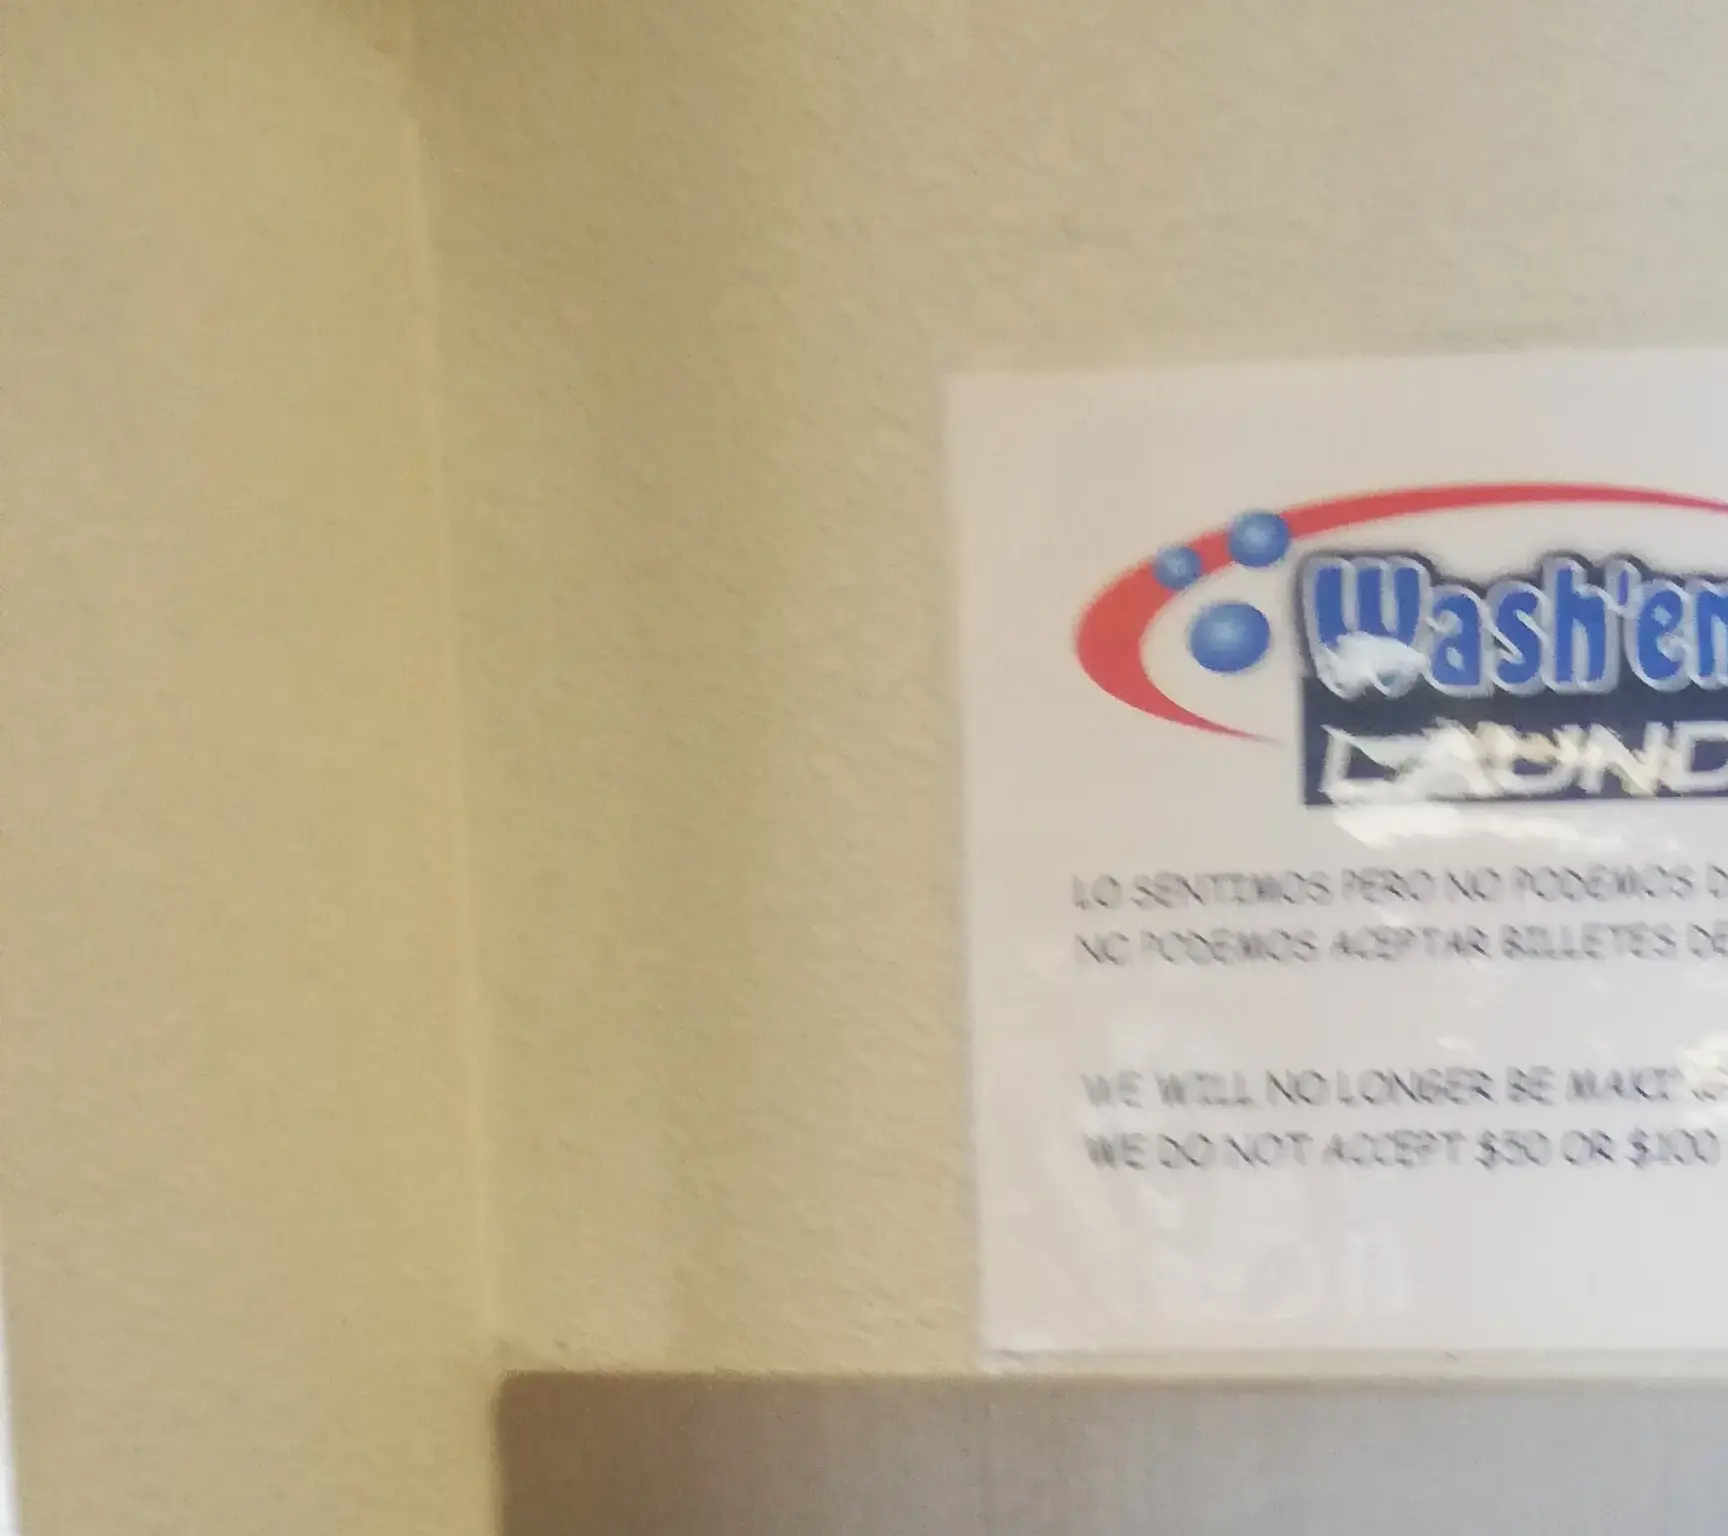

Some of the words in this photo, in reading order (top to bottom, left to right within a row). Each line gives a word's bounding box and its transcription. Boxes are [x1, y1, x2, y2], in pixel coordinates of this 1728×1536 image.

[1070, 873, 1123, 910] LO
[1130, 869, 1333, 908] SENTIMOS
[1341, 867, 1437, 902] PERO
[1444, 866, 1503, 902] NO
[1511, 863, 1696, 902] PODEMOS
[1073, 930, 1132, 966] NO
[1140, 928, 1320, 965] PODEMOS
[1330, 924, 1492, 961] ACEPTAR
[1500, 920, 1678, 961] BILLETES
[1079, 1069, 1144, 1109] WE
[1154, 1068, 1254, 1109] WILL
[1265, 1068, 1330, 1107] NO
[1336, 1066, 1498, 1107] LONGER
[1506, 1065, 1555, 1105] BE
[1083, 1133, 1146, 1172] WE
[1157, 1132, 1214, 1169] DO
[1222, 1131, 1314, 1168] NOT
[1322, 1130, 1466, 1168] ACCEPT
[1474, 1129, 1551, 1171] $50
[1559, 1129, 1616, 1166] OR
[1625, 1127, 1722, 1172] $100
